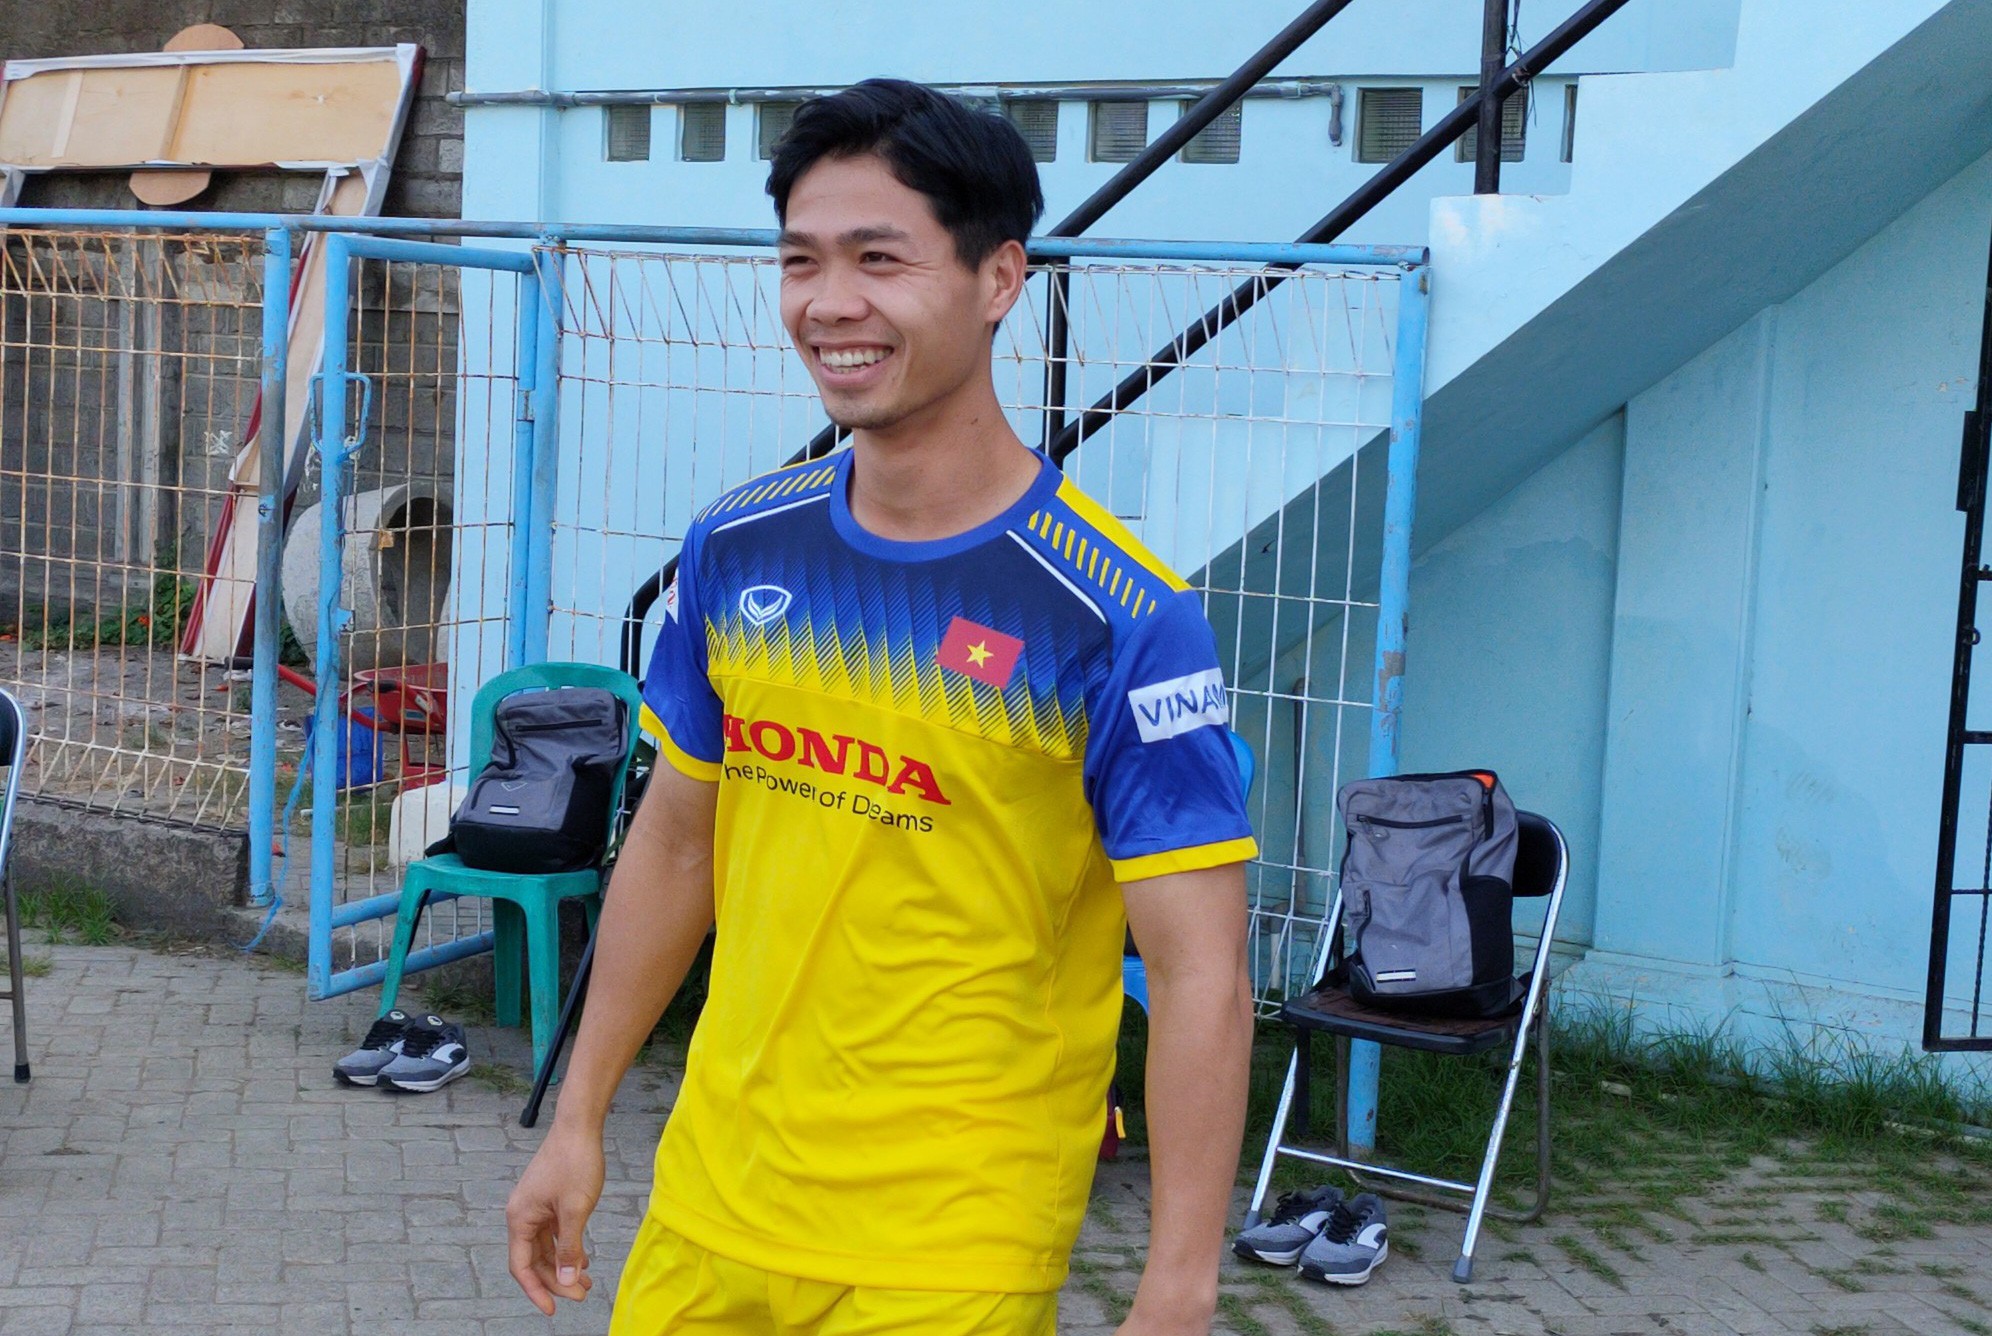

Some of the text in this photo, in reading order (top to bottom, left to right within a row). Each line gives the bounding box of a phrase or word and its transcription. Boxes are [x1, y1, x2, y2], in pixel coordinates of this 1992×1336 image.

[723, 714, 951, 806] HONDA
[724, 763, 753, 780] he
[819, 791, 847, 809] of
[852, 794, 934, 833] Deams
